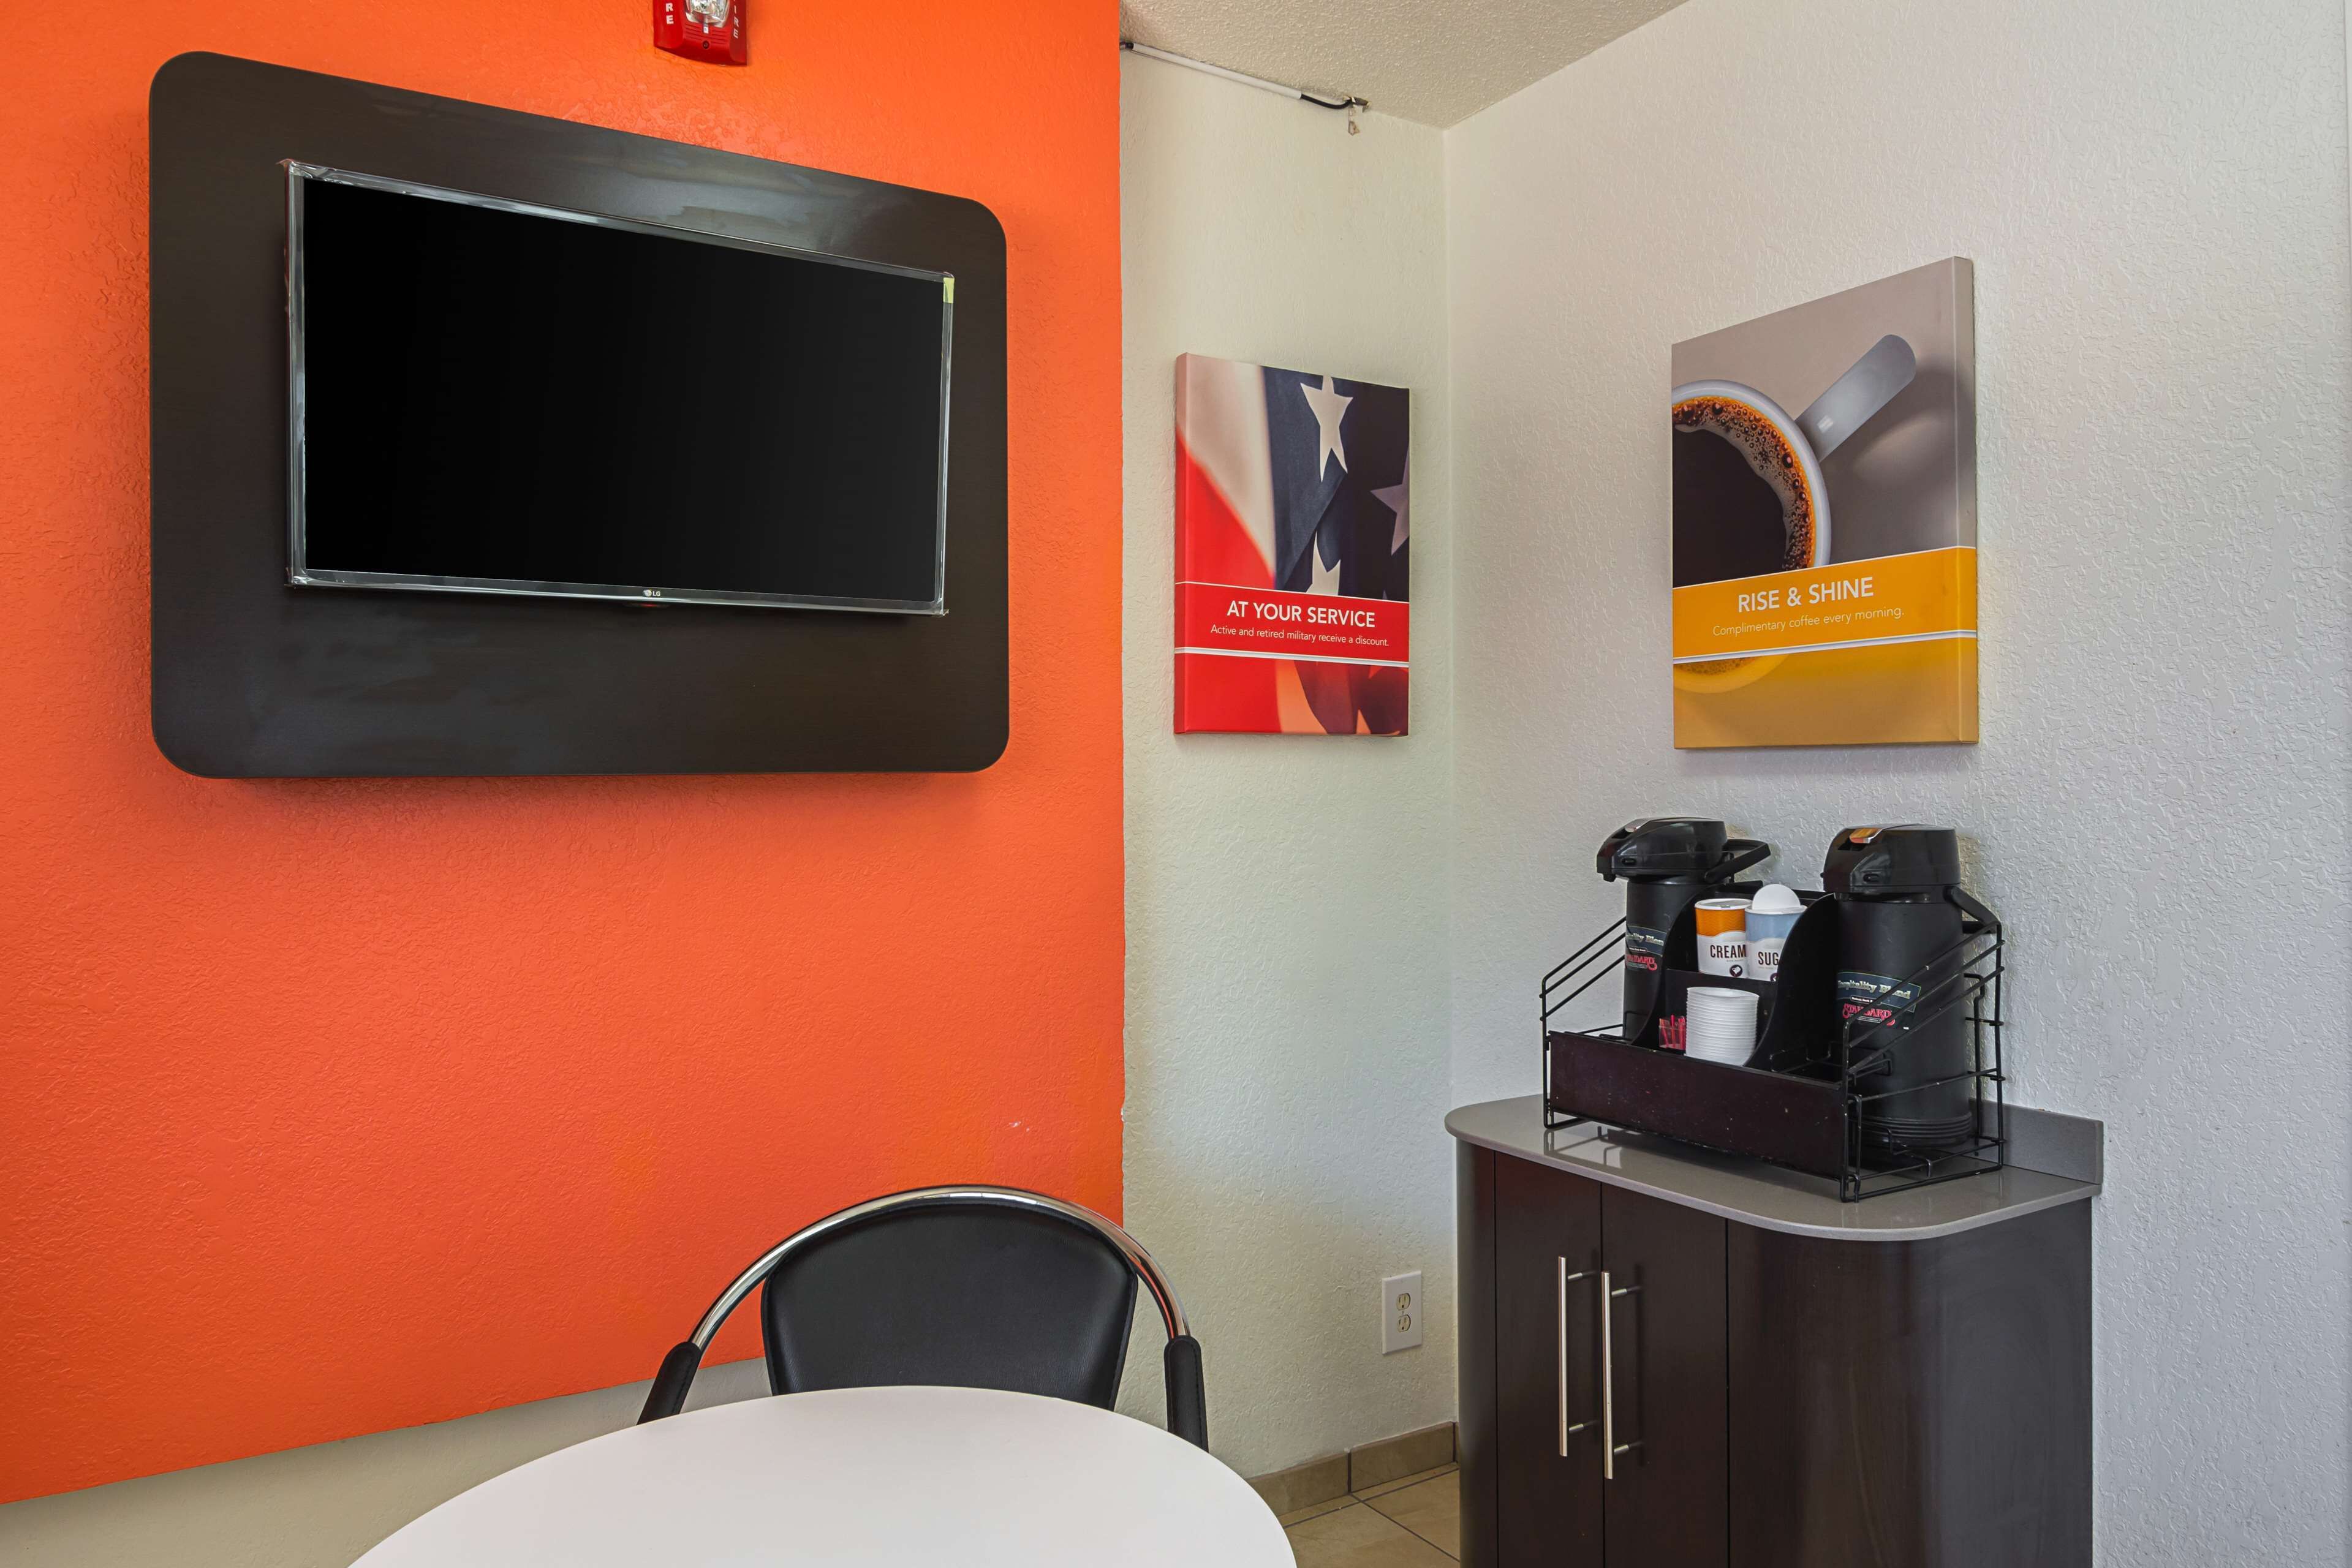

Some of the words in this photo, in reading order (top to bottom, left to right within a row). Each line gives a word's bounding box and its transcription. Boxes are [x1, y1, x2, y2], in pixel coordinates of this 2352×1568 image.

[1738, 589, 1780, 613] RISE
[1787, 587, 1802, 606] &
[1809, 576, 1874, 604] SHINE
[1227, 600, 1249, 617] AT
[1253, 602, 1302, 622] YOUR
[1307, 606, 1375, 628] SERVICE
[1713, 621, 1786, 638] Complimentary
[1788, 614, 1820, 628] coffee
[1823, 613, 1851, 624] every
[1855, 606, 1905, 620] morning.
[1211, 624, 1236, 635] Active
[1239, 627, 1254, 636] and
[1257, 630, 1284, 638] retired
[1287, 630, 1316, 643] military
[1318, 634, 1346, 643] receive
[1355, 635, 1390, 646] discount.
[1710, 944, 1747, 958] CREAM
